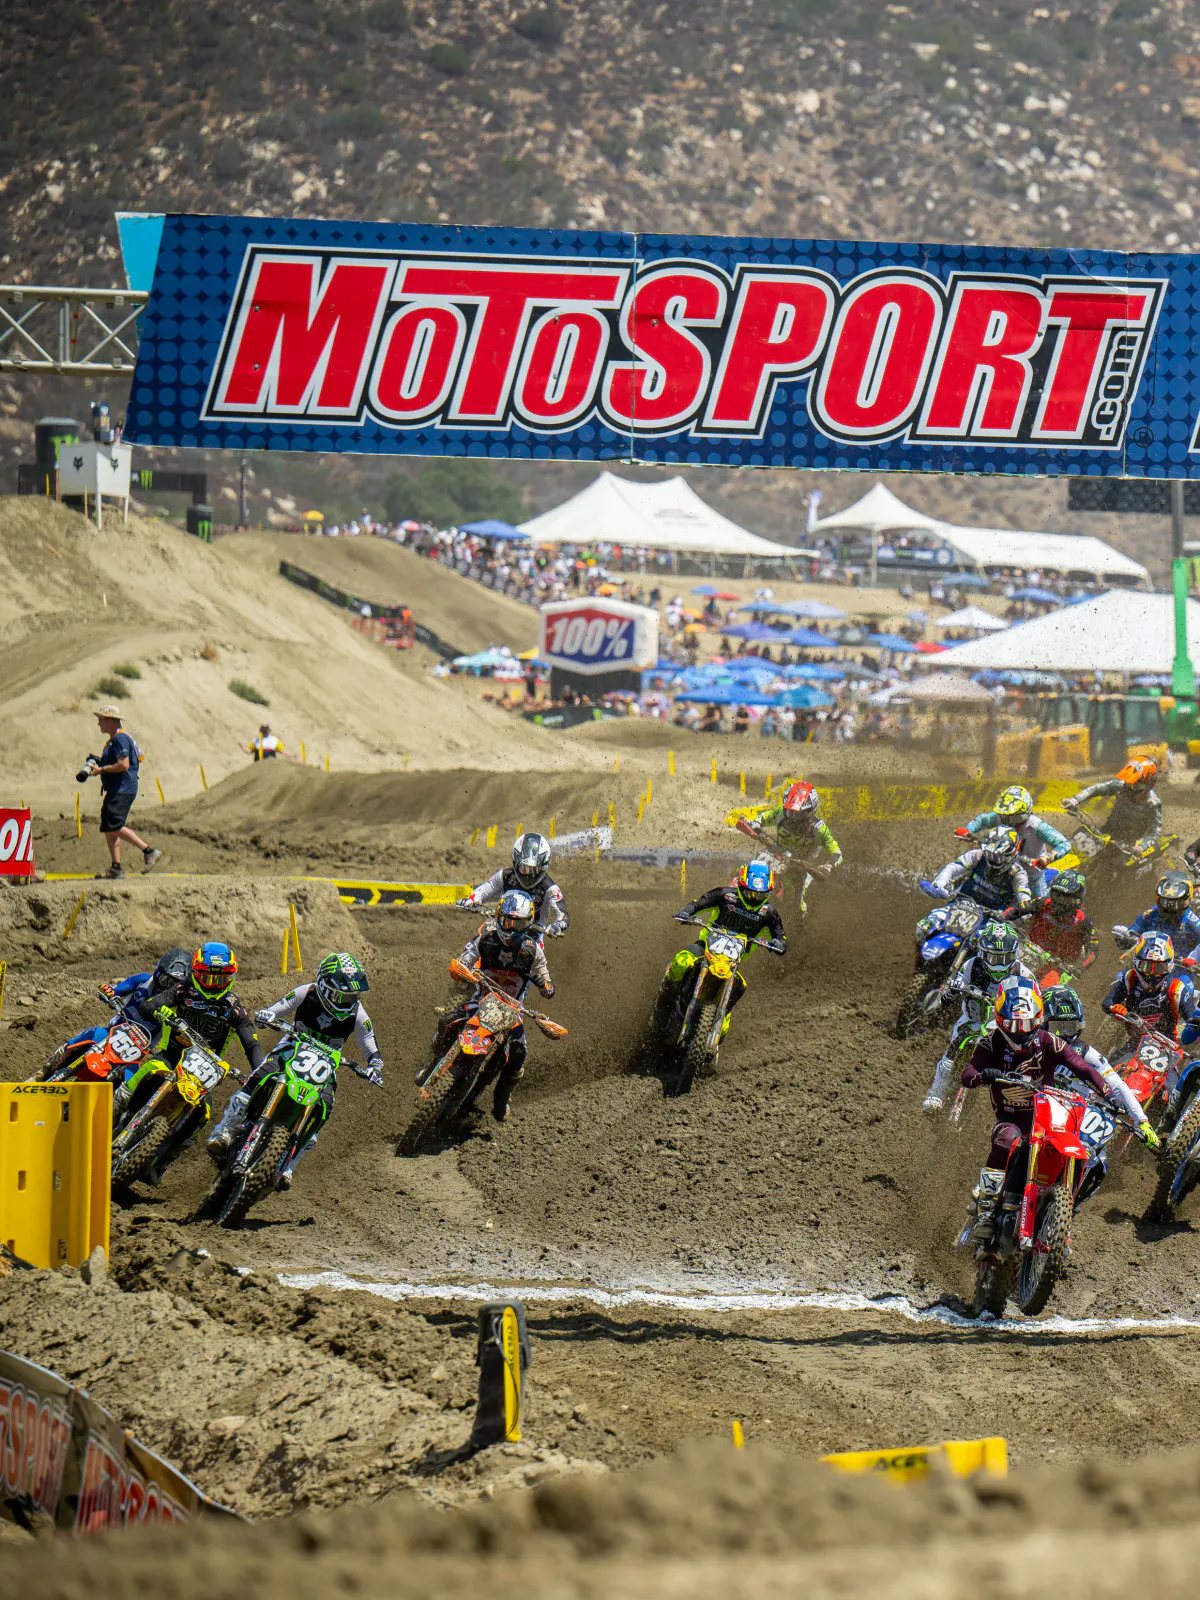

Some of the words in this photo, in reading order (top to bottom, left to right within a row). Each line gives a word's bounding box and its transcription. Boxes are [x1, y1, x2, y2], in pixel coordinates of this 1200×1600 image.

[551, 617, 630, 657] 100%
[709, 937, 743, 960] 43
[109, 1029, 141, 1063] 159
[182, 1052, 218, 1090] 331
[291, 1050, 332, 1084] 30
[11, 1085, 69, 1095] ACERBIS
